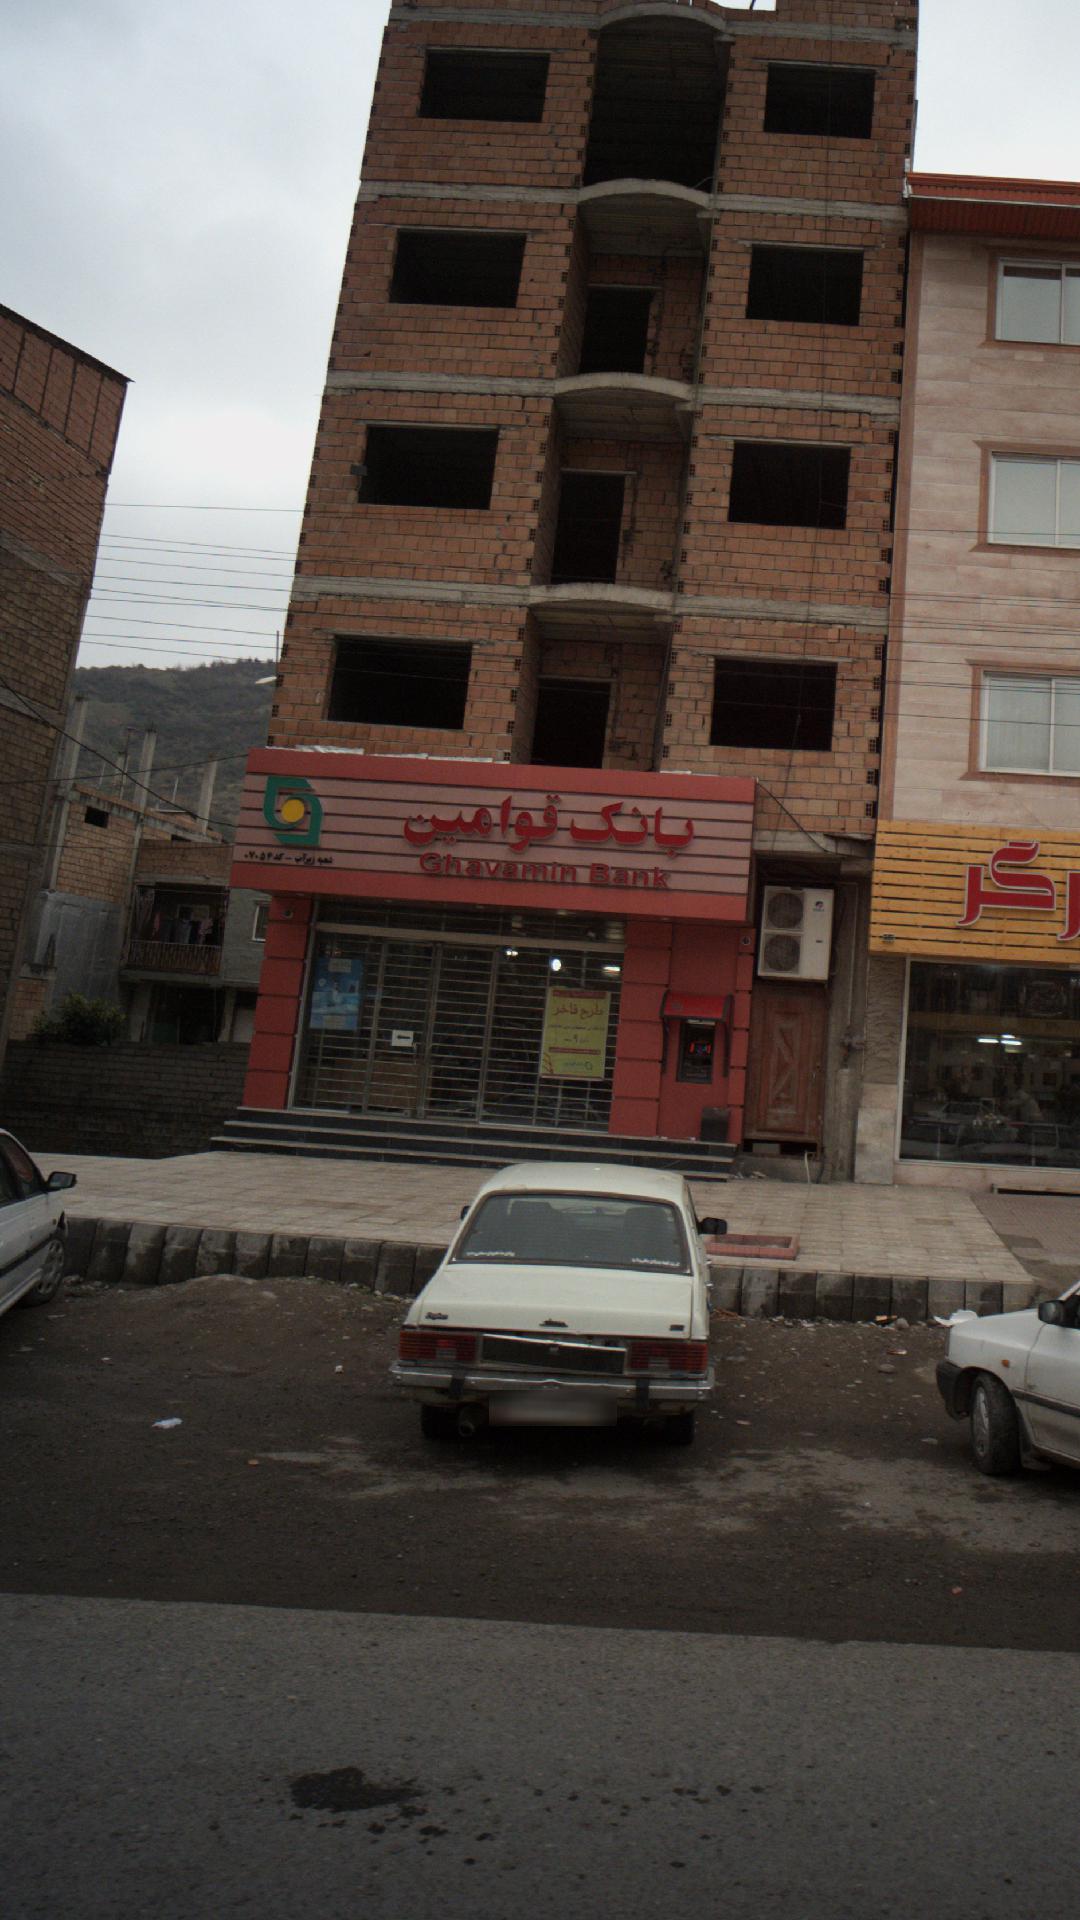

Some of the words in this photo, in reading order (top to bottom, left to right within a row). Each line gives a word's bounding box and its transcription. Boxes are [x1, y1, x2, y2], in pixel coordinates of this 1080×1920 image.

[403, 794, 562, 854] قوامین
[570, 801, 694, 860] بانک
[419, 851, 578, 885] Ghavamin
[589, 862, 674, 890] Bank
